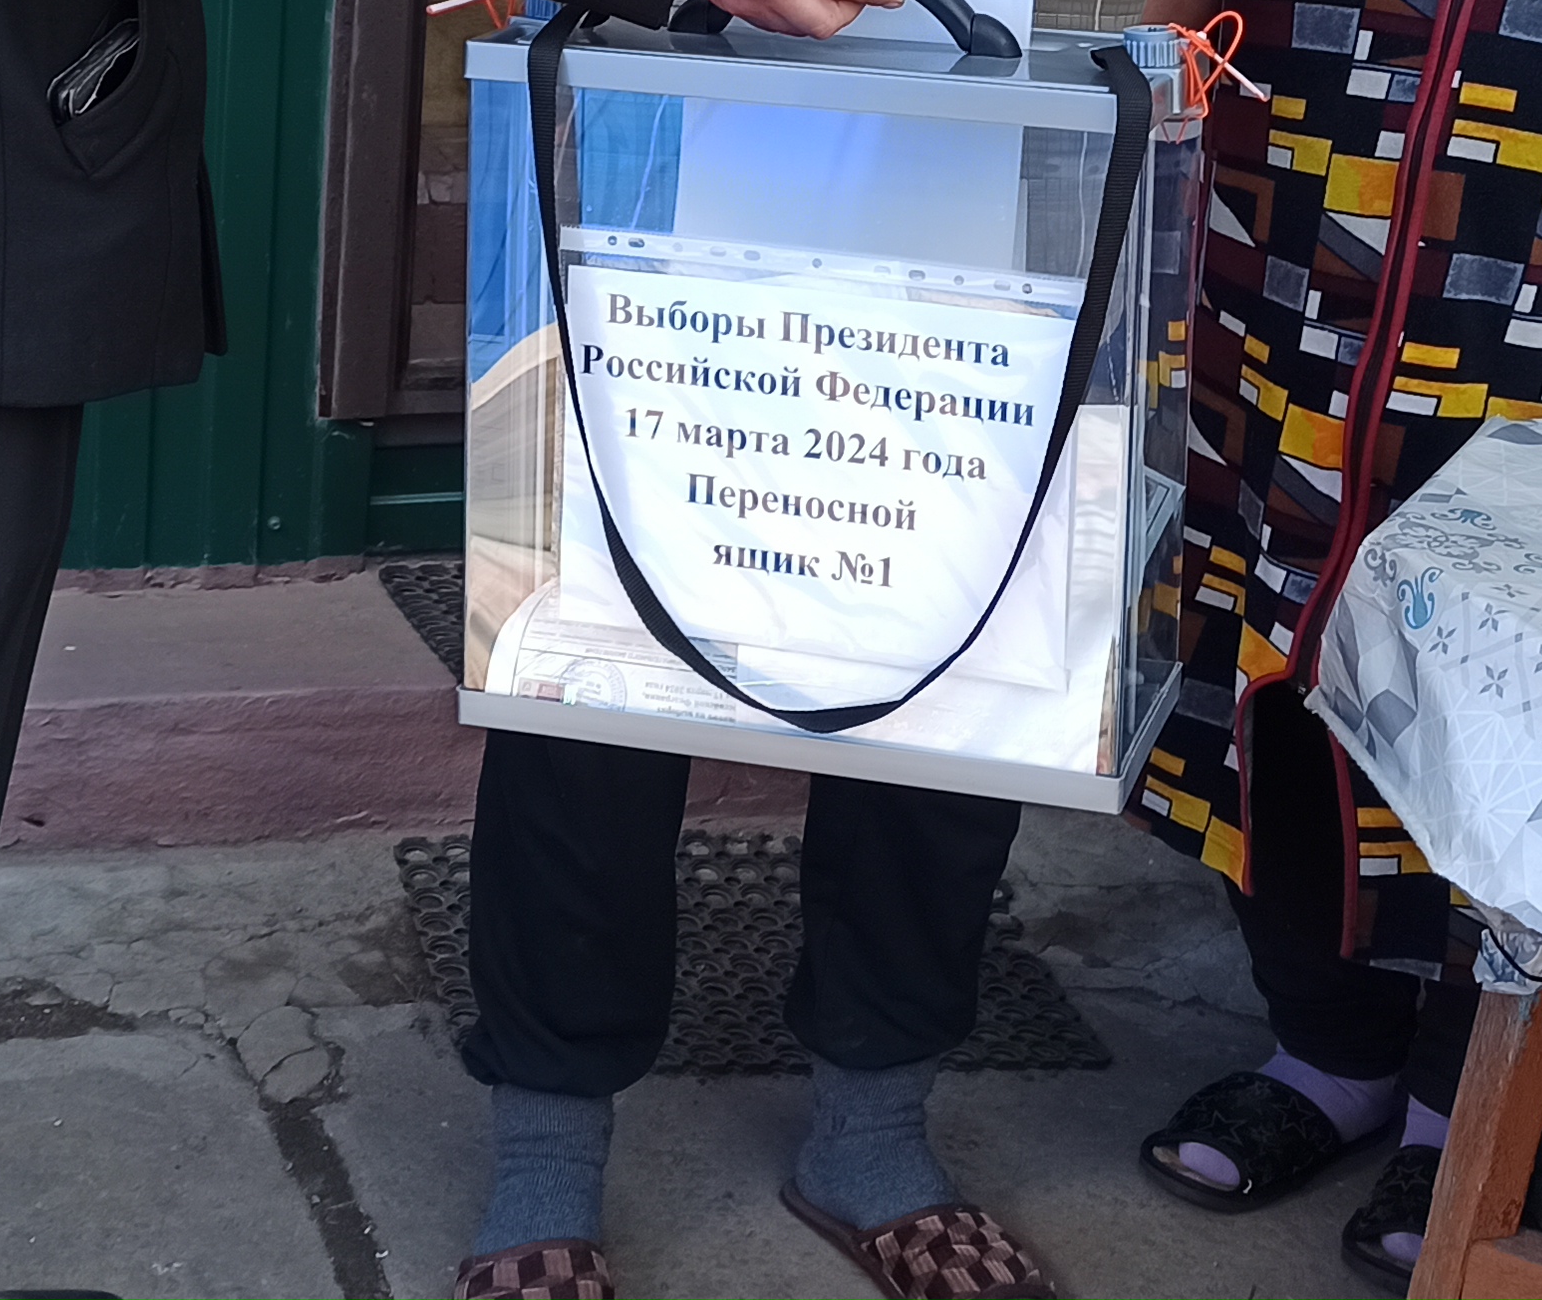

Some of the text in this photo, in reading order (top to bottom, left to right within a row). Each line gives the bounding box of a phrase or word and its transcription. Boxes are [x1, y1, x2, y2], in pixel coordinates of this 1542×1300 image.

[607, 292, 1010, 368] Выборы Президента
[580, 343, 1036, 427] Российской Федерации
[624, 407, 987, 482] 17 марта 2024 года
[685, 472, 917, 531] Переносной
[712, 543, 894, 589] ящик №1
